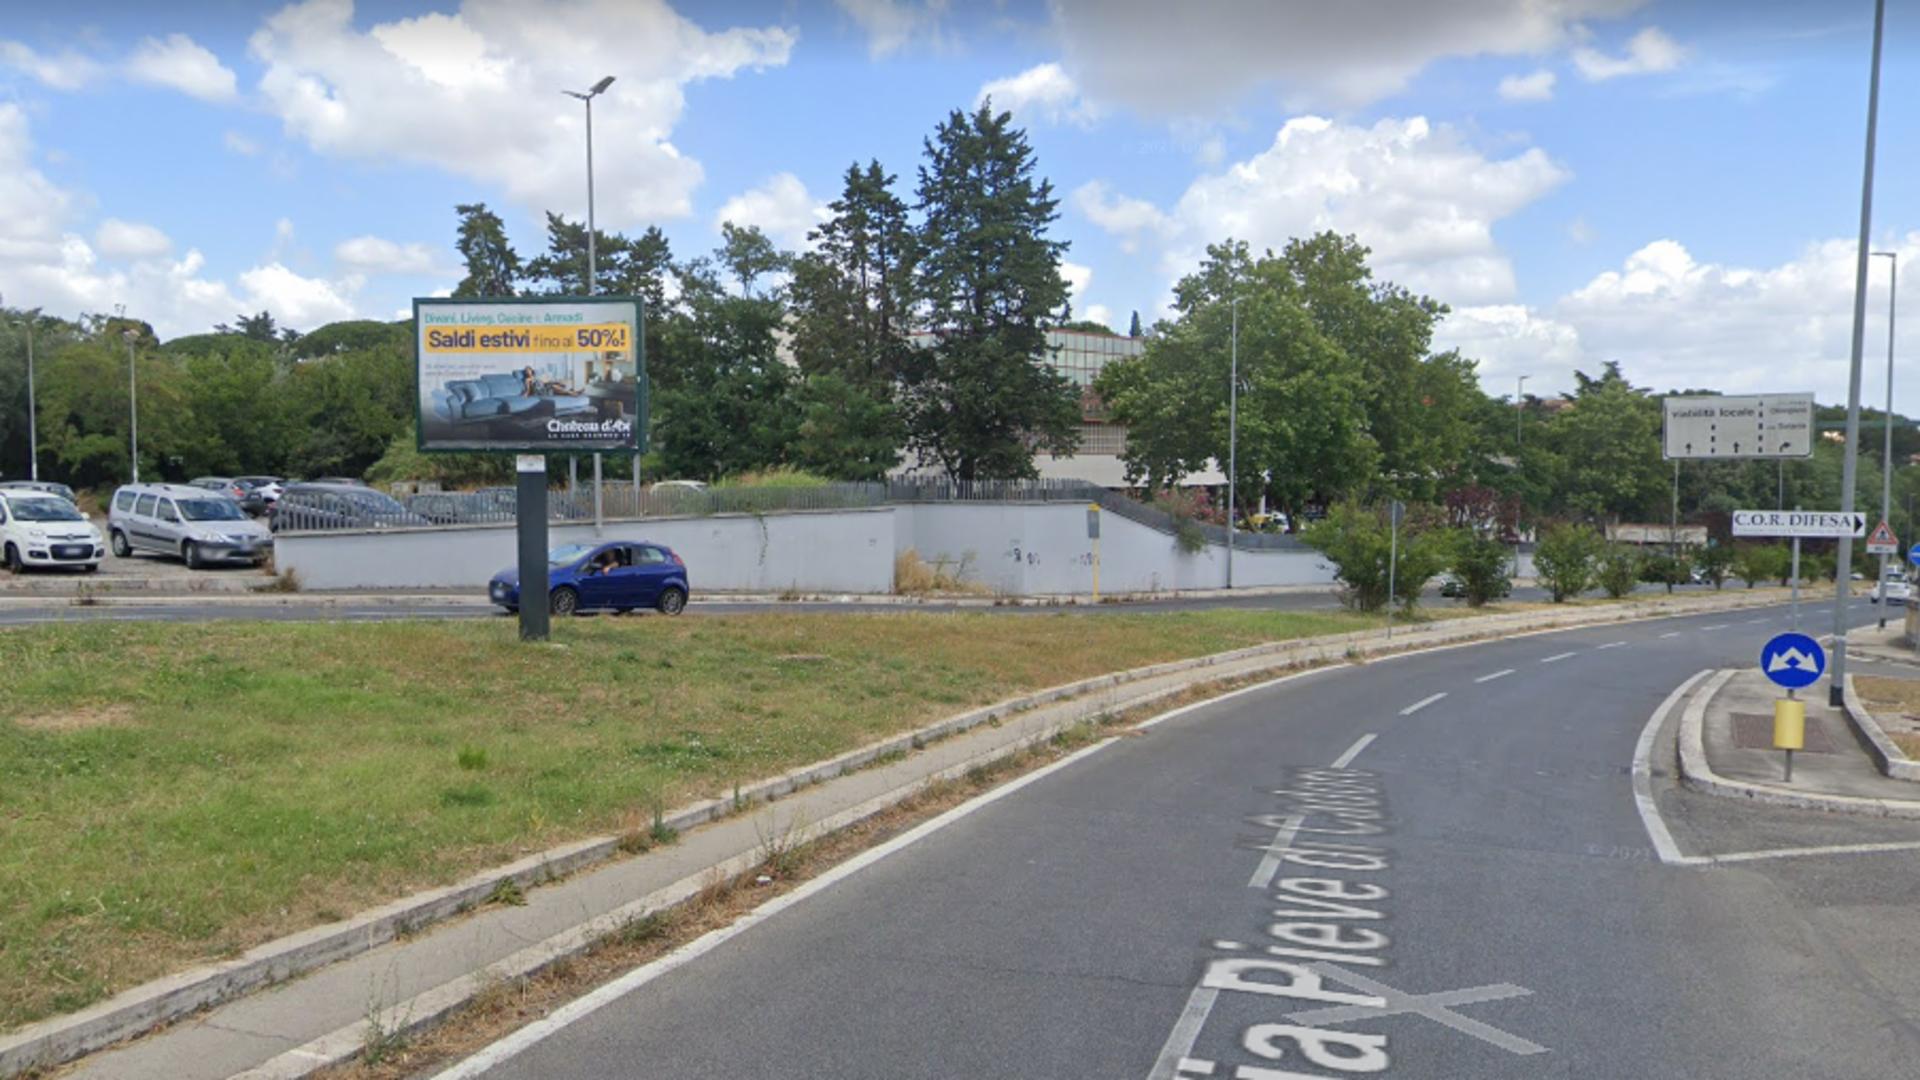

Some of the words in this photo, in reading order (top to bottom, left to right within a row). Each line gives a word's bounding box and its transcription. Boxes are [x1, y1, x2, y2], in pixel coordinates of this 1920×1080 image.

[428, 329, 475, 348] Saldi
[479, 329, 530, 348] estivi
[533, 335, 560, 348] fino
[561, 335, 574, 348] al
[577, 328, 625, 348] 50%!
[1734, 513, 1785, 527] C.O.R.
[1789, 514, 1851, 528] DIFESA
